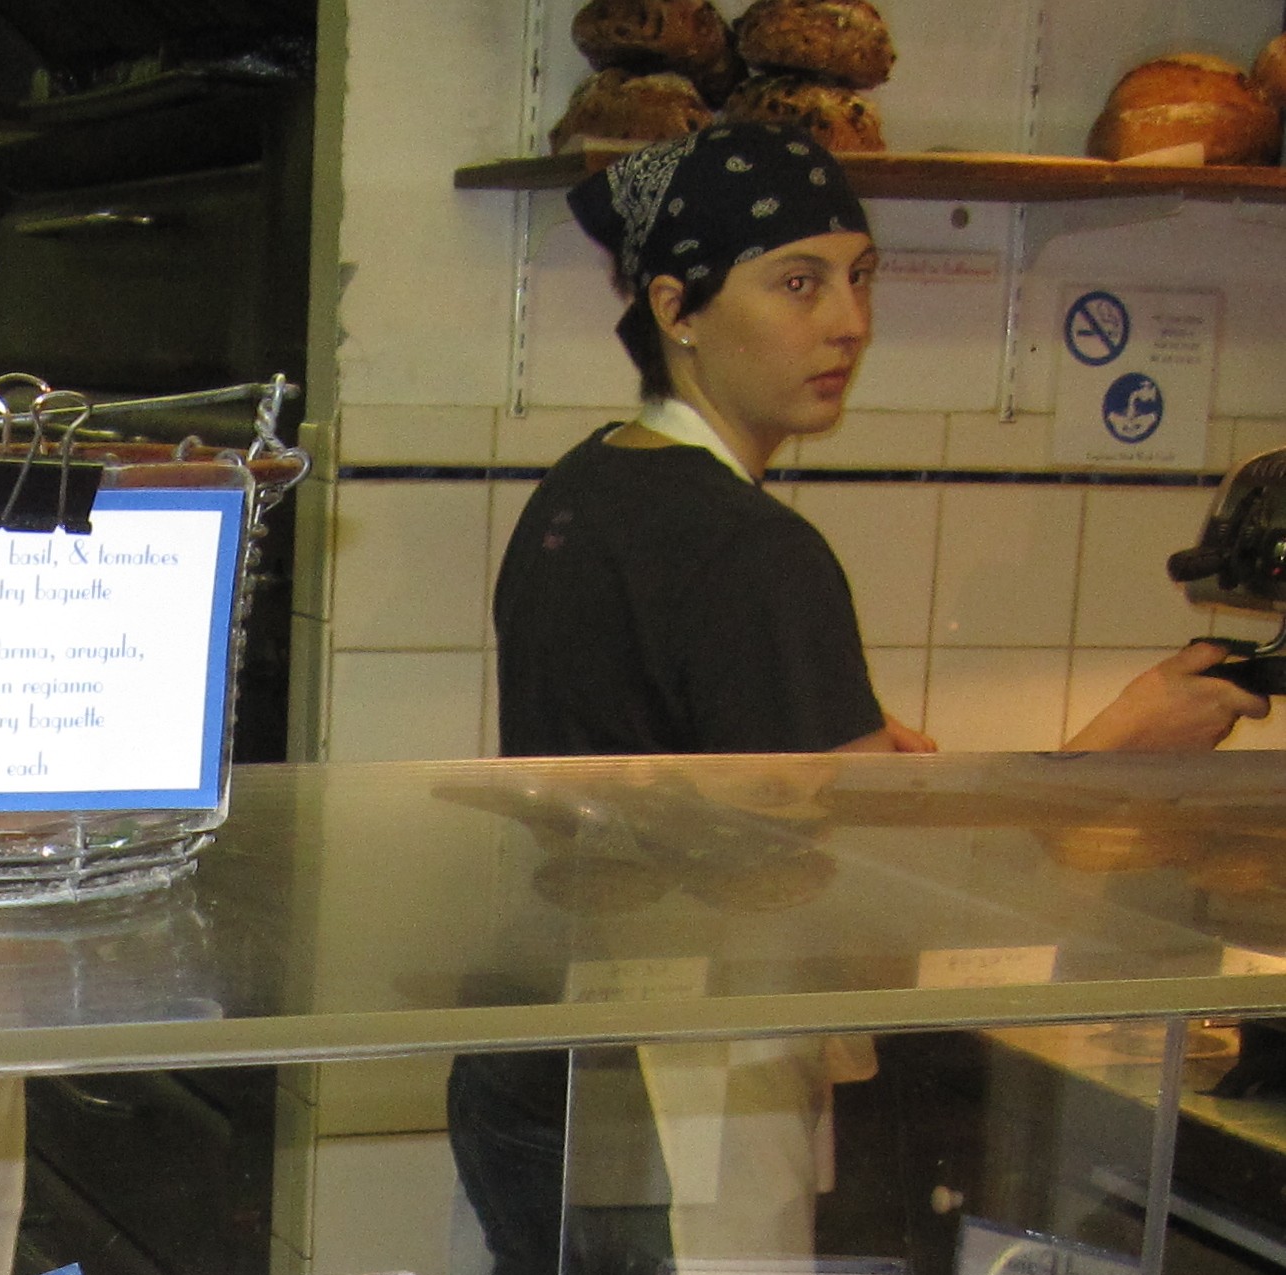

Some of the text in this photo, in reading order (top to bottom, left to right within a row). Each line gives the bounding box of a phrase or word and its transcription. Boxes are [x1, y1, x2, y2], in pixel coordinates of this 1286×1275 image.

[9, 539, 59, 568] basil,
[68, 538, 90, 565] &
[97, 542, 179, 567] tomatoes
[35, 575, 112, 606] baguette
[65, 633, 145, 664] arugula,
[22, 678, 104, 699] regianno
[29, 703, 105, 735] baguette
[6, 751, 49, 777] each
